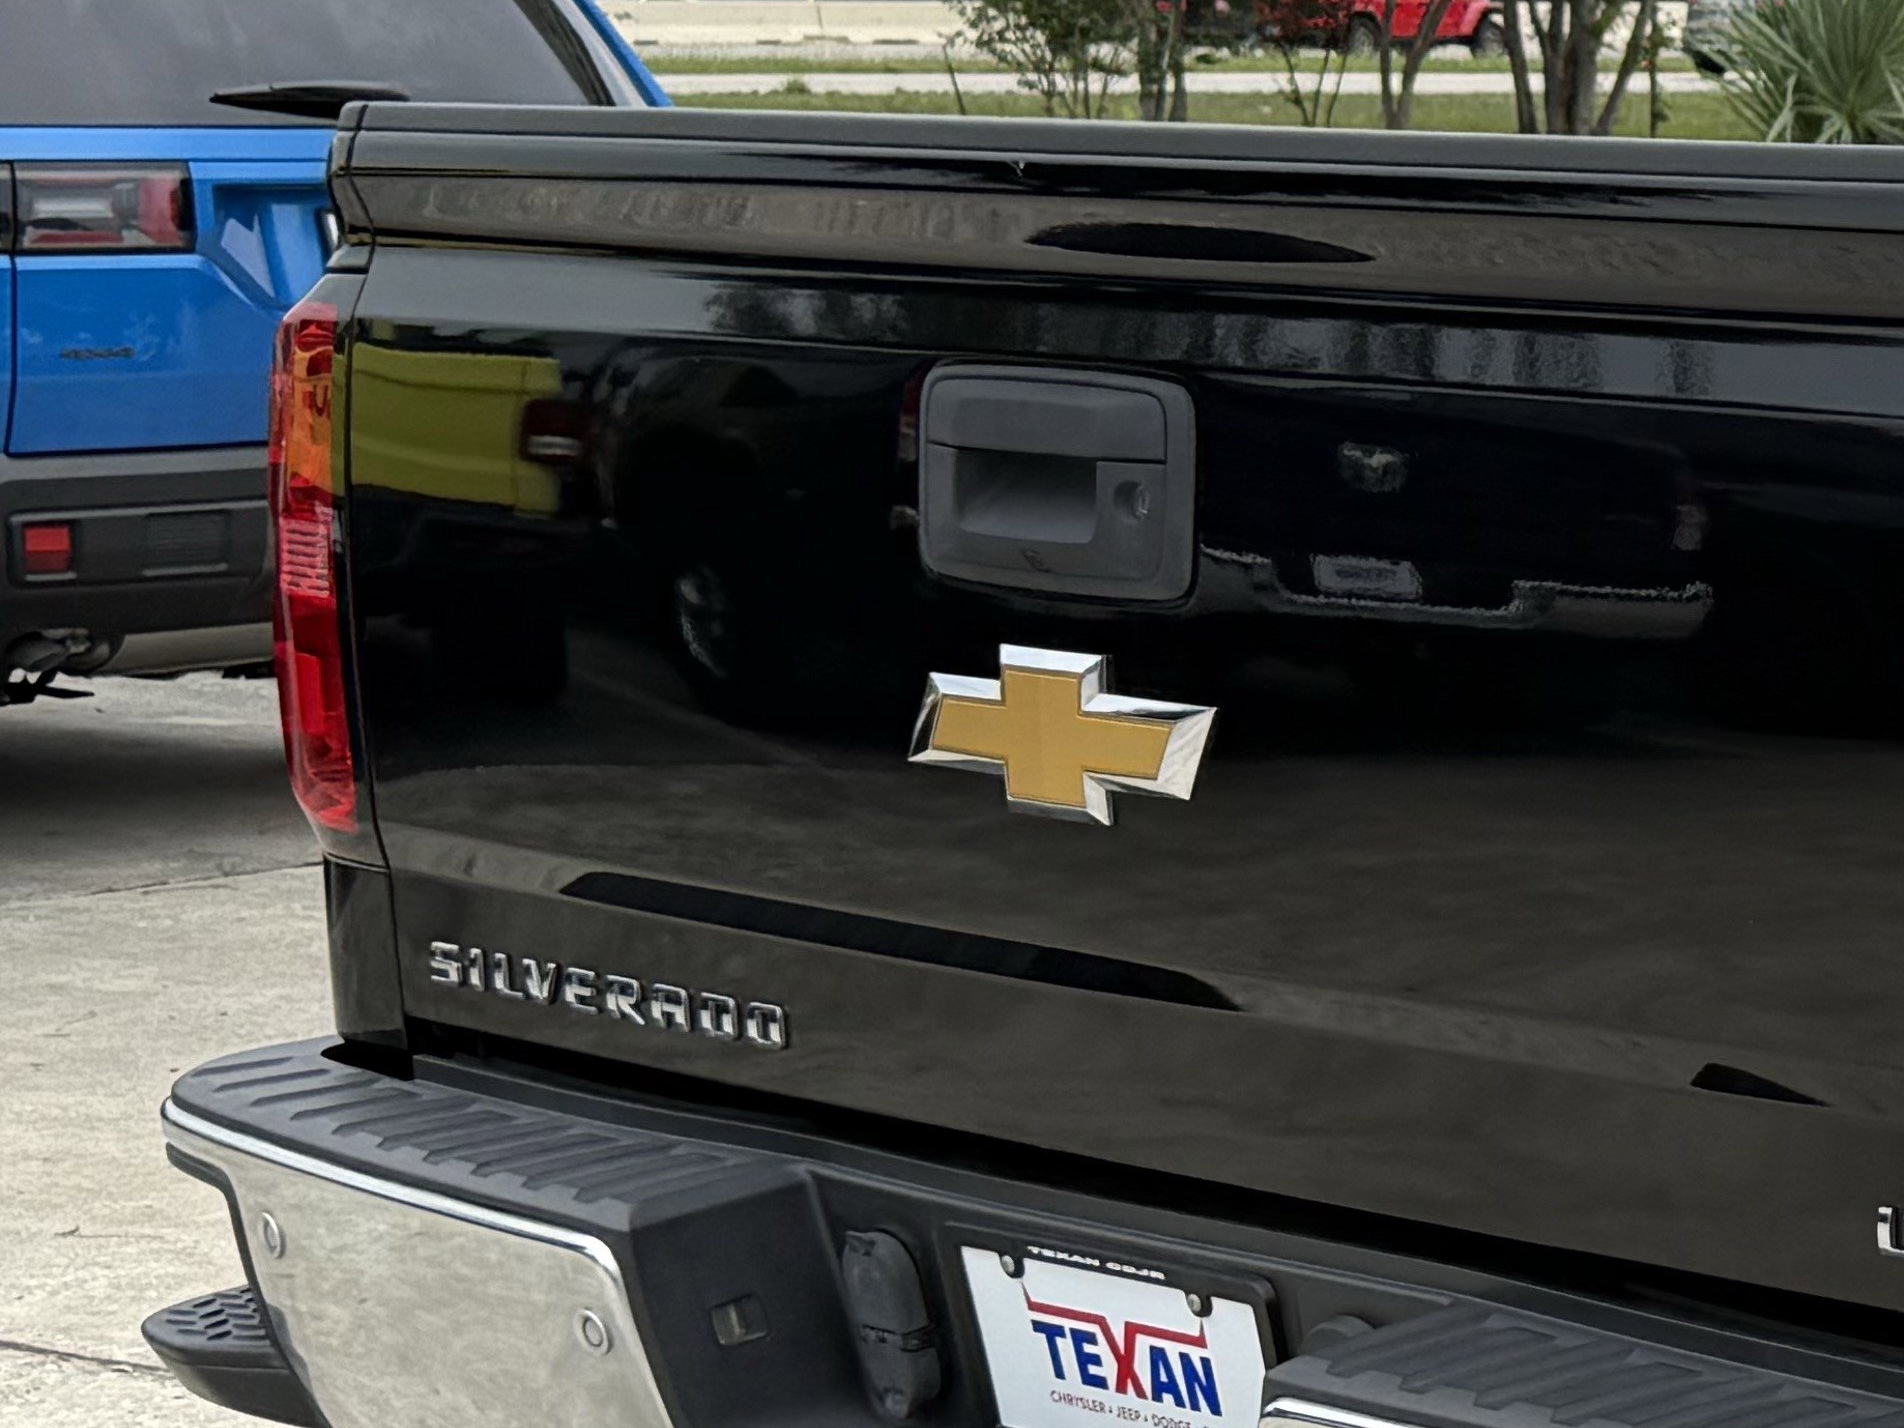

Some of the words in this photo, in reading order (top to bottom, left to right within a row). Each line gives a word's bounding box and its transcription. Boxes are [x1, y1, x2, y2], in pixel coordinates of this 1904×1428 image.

[429, 940, 790, 1051] SILVERADO
[1027, 1245, 1101, 1267] TEXAN
[1031, 1315, 1223, 1417] TEXAN
[1049, 1389, 1106, 1414] CHRYSLER
[1116, 1405, 1141, 1422] JEEP
